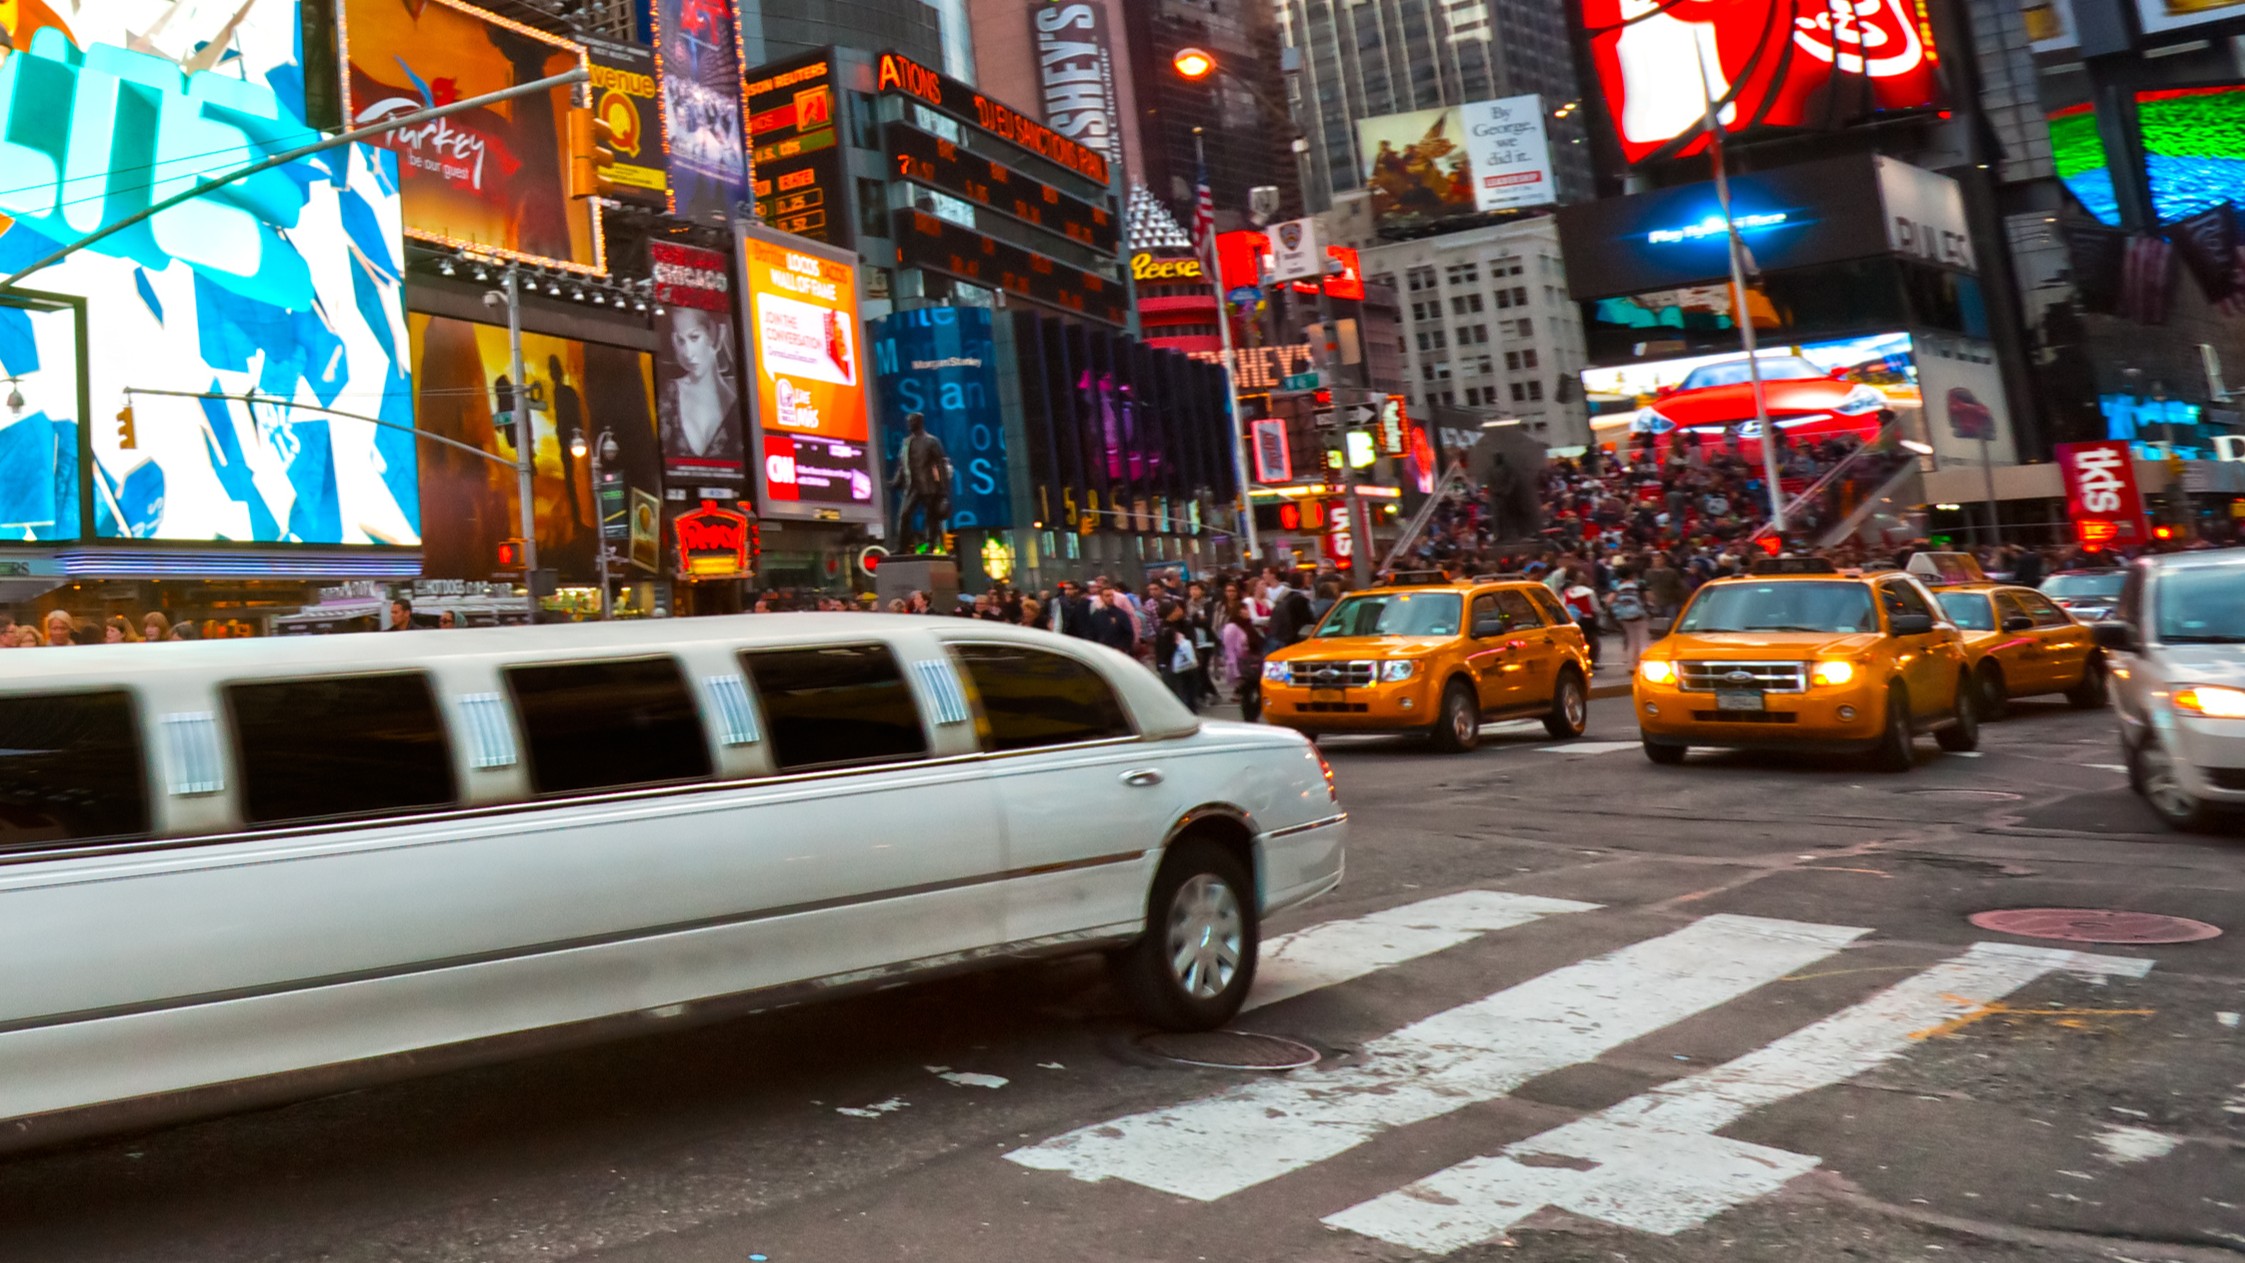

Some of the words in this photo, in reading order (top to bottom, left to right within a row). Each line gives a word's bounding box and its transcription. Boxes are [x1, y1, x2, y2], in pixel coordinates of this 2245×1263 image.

[588, 63, 656, 98] venue
[773, 61, 828, 88] REUTERS
[599, 88, 641, 158] Q
[1491, 106, 1513, 121] By
[1496, 138, 1519, 148] we
[408, 149, 422, 167] be
[424, 159, 442, 172] our
[443, 163, 470, 179] guest
[1487, 150, 1513, 167] did
[2075, 447, 2127, 514] tkts
